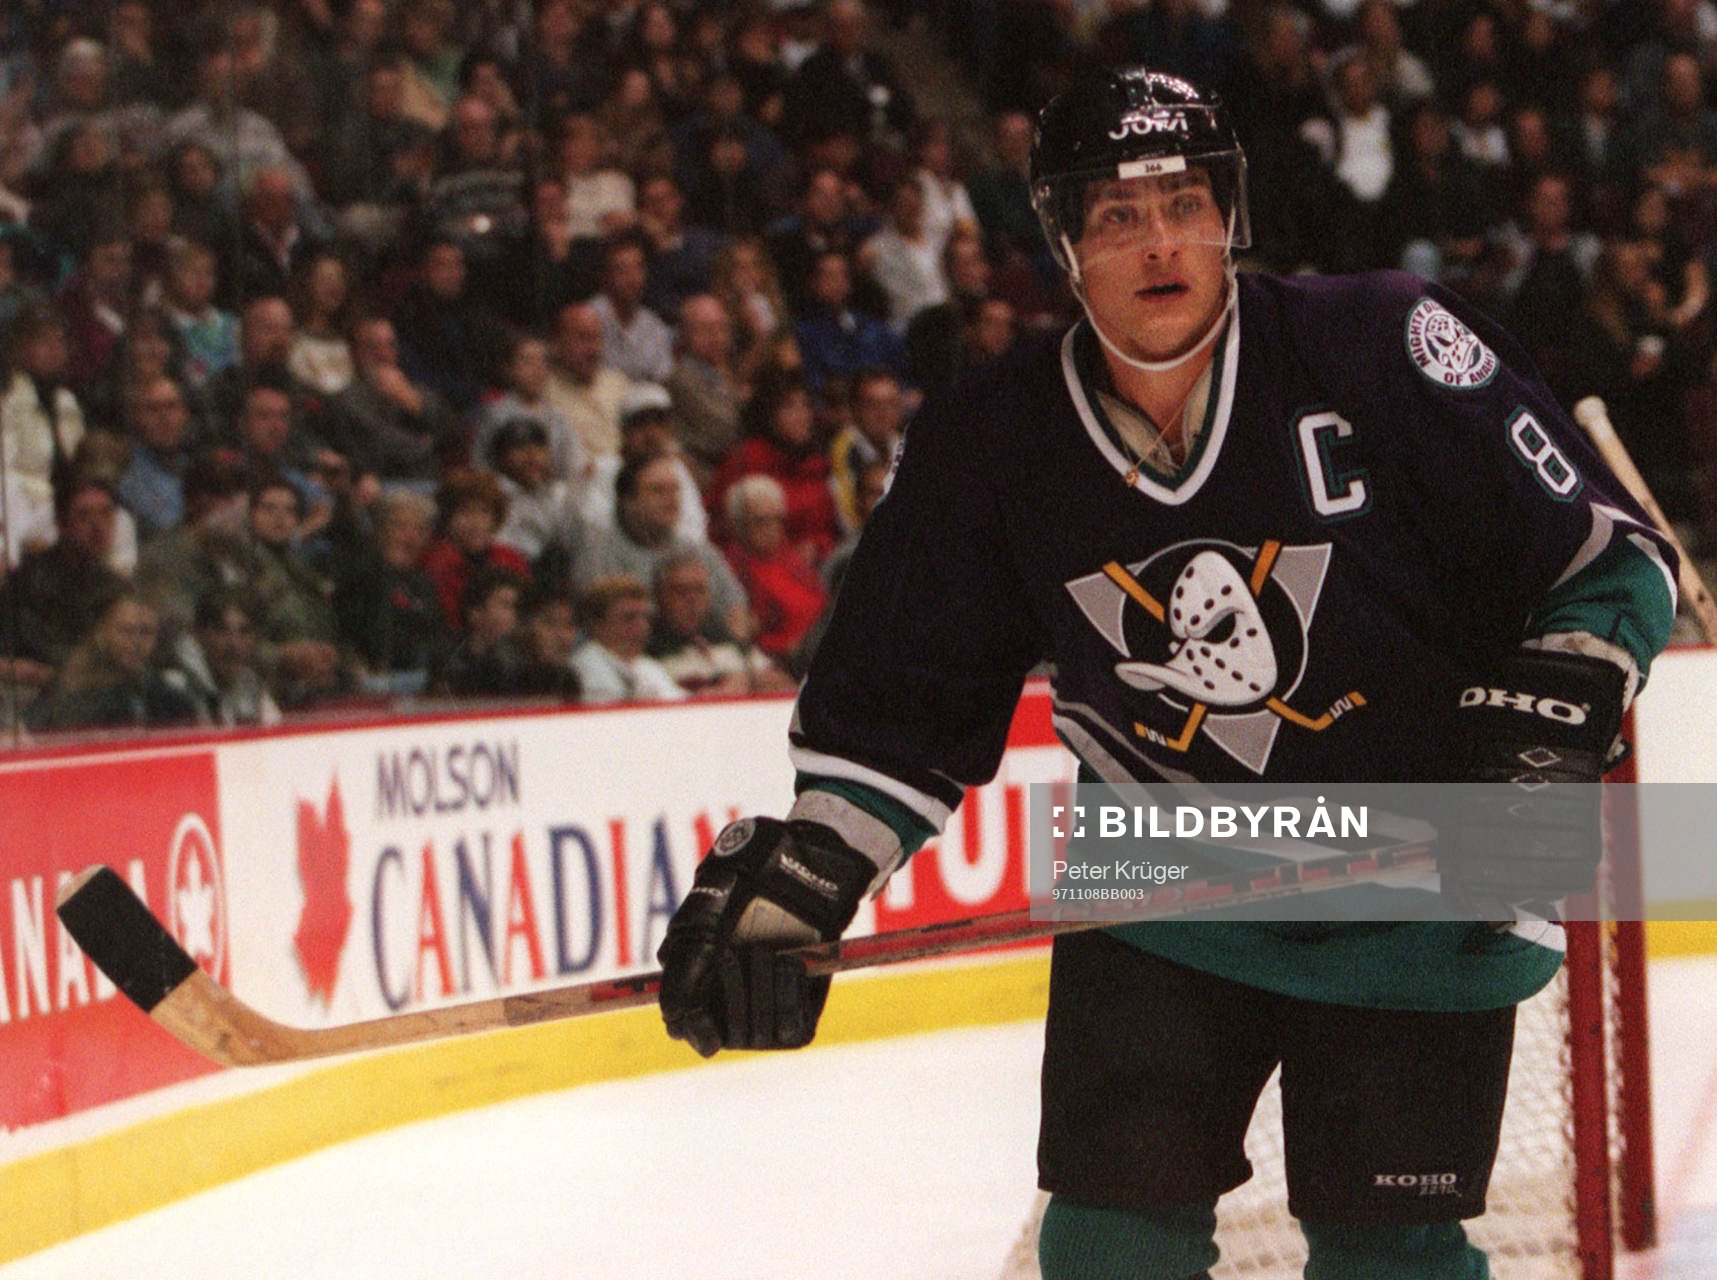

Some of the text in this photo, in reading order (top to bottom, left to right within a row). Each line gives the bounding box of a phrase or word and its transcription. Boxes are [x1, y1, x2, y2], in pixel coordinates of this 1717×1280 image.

[1409, 309, 1432, 368] MIGHTY
[1444, 371, 1464, 385] OF
[1297, 409, 1368, 517] C
[1508, 409, 1580, 499] 8
[376, 741, 520, 820] MOLSON
[1374, 1173, 1457, 1186] KOHO
